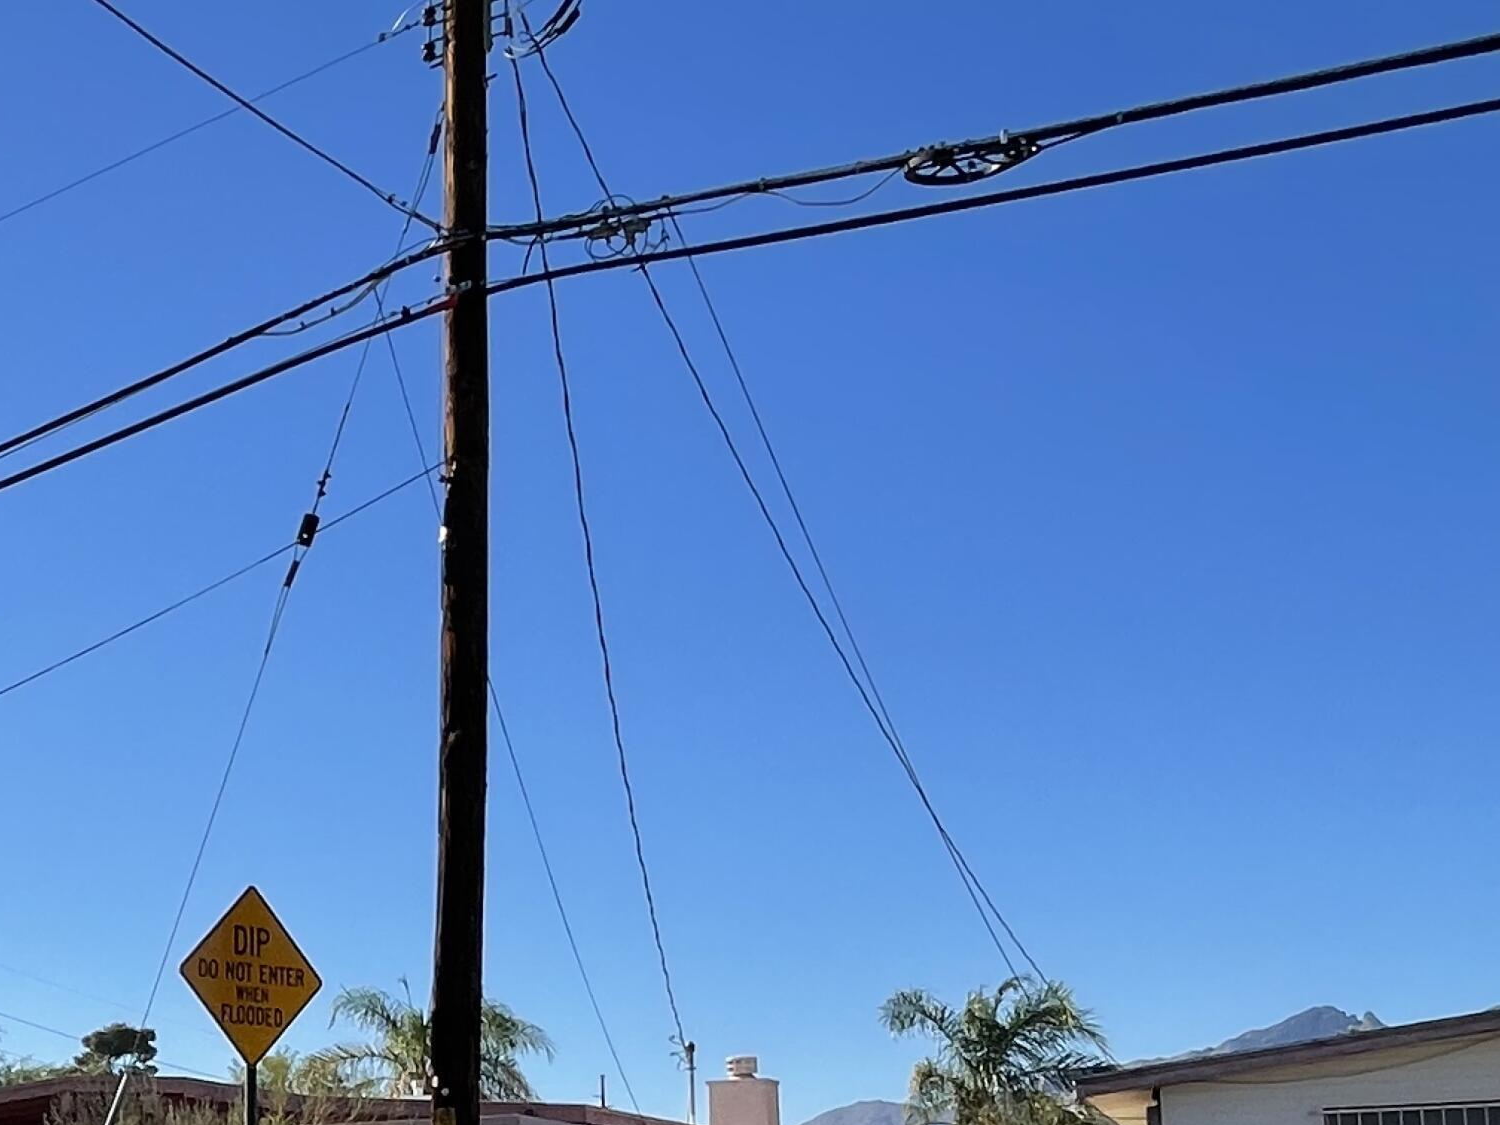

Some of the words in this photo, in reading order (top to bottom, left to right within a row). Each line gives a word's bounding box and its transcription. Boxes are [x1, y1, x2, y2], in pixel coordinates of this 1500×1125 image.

[233, 924, 271, 957] DIP
[198, 958, 219, 979] DO
[225, 960, 253, 982] NOT
[259, 964, 305, 987] ENTER
[235, 986, 269, 1003] WHEN
[220, 1003, 283, 1028] FLOODED
